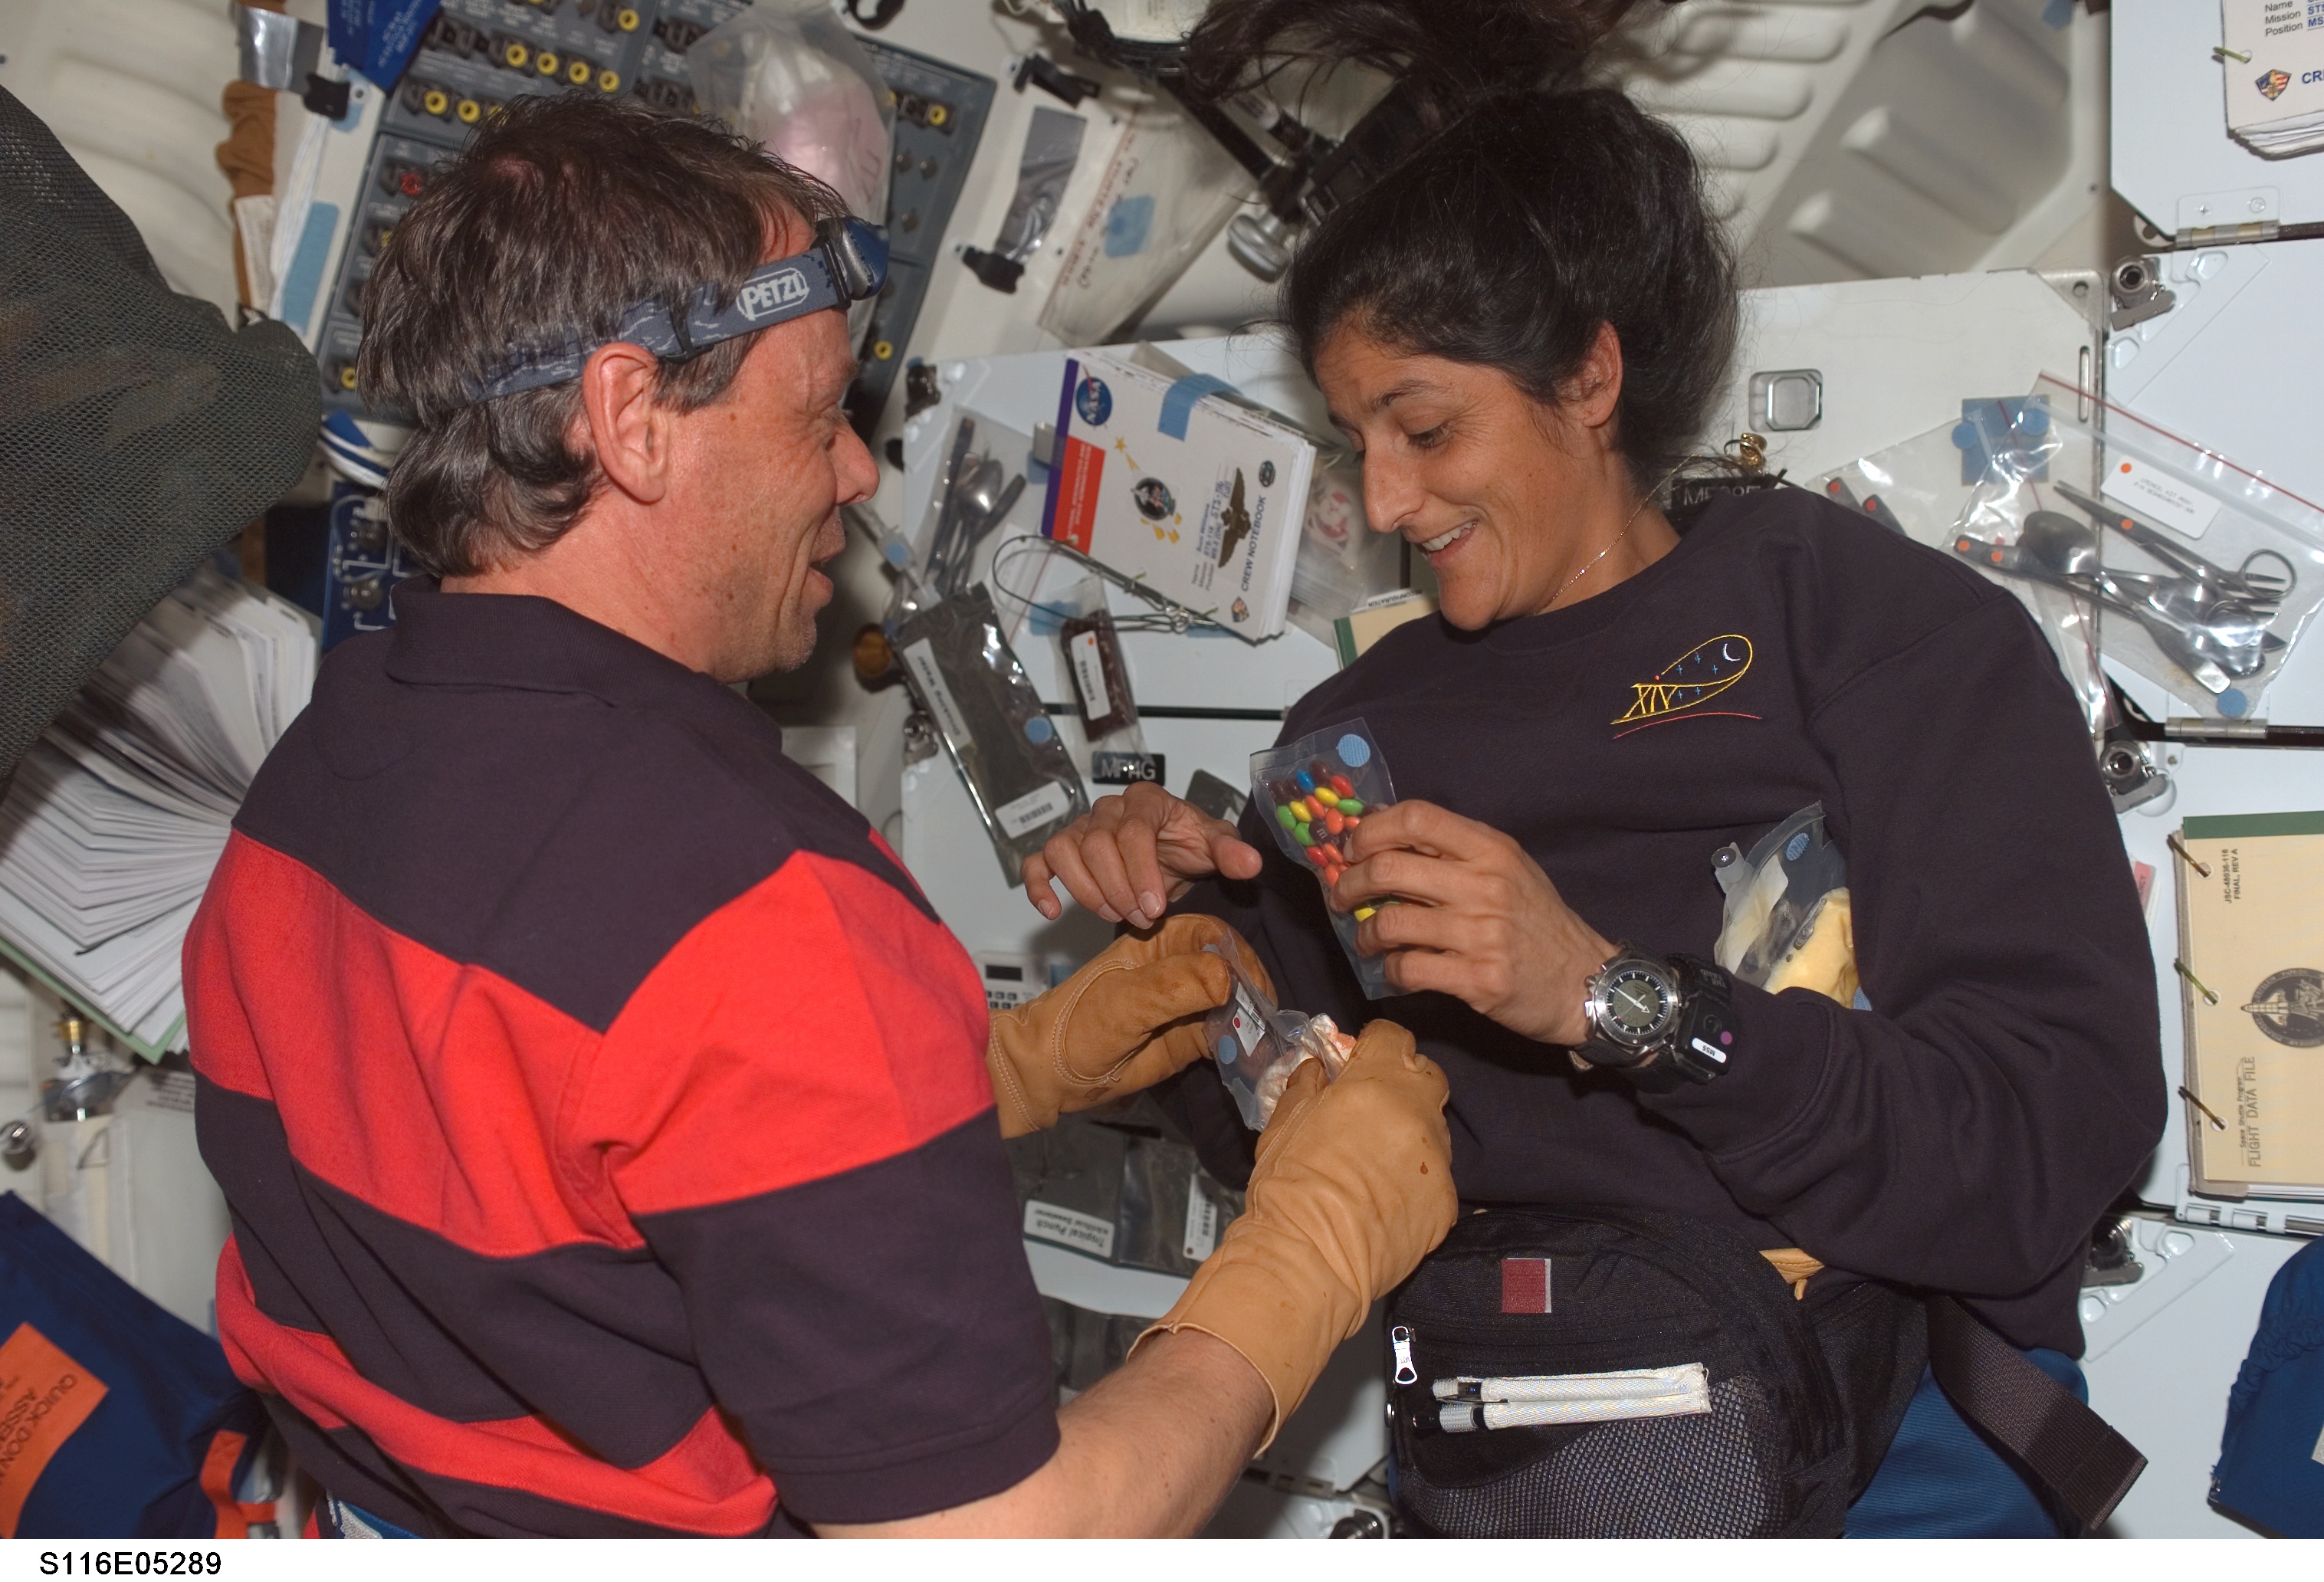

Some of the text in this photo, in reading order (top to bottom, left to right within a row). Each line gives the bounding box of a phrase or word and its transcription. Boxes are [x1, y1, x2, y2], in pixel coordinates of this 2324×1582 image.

[2265, 1, 2293, 12] Name
[2265, 11, 2301, 25] Mission
[2265, 22, 2303, 37] Position
[2302, 70, 2324, 84] CR
[740, 271, 811, 321] PETZL
[1241, 495, 1266, 592] CREW NOTEBOOK
[2231, 856, 2240, 872] REV
[2238, 1104, 2247, 1127] Shuttle
[2244, 1056, 2262, 1167] FLIGHT DATA FILE
[26, 1373, 77, 1428] QUICK
